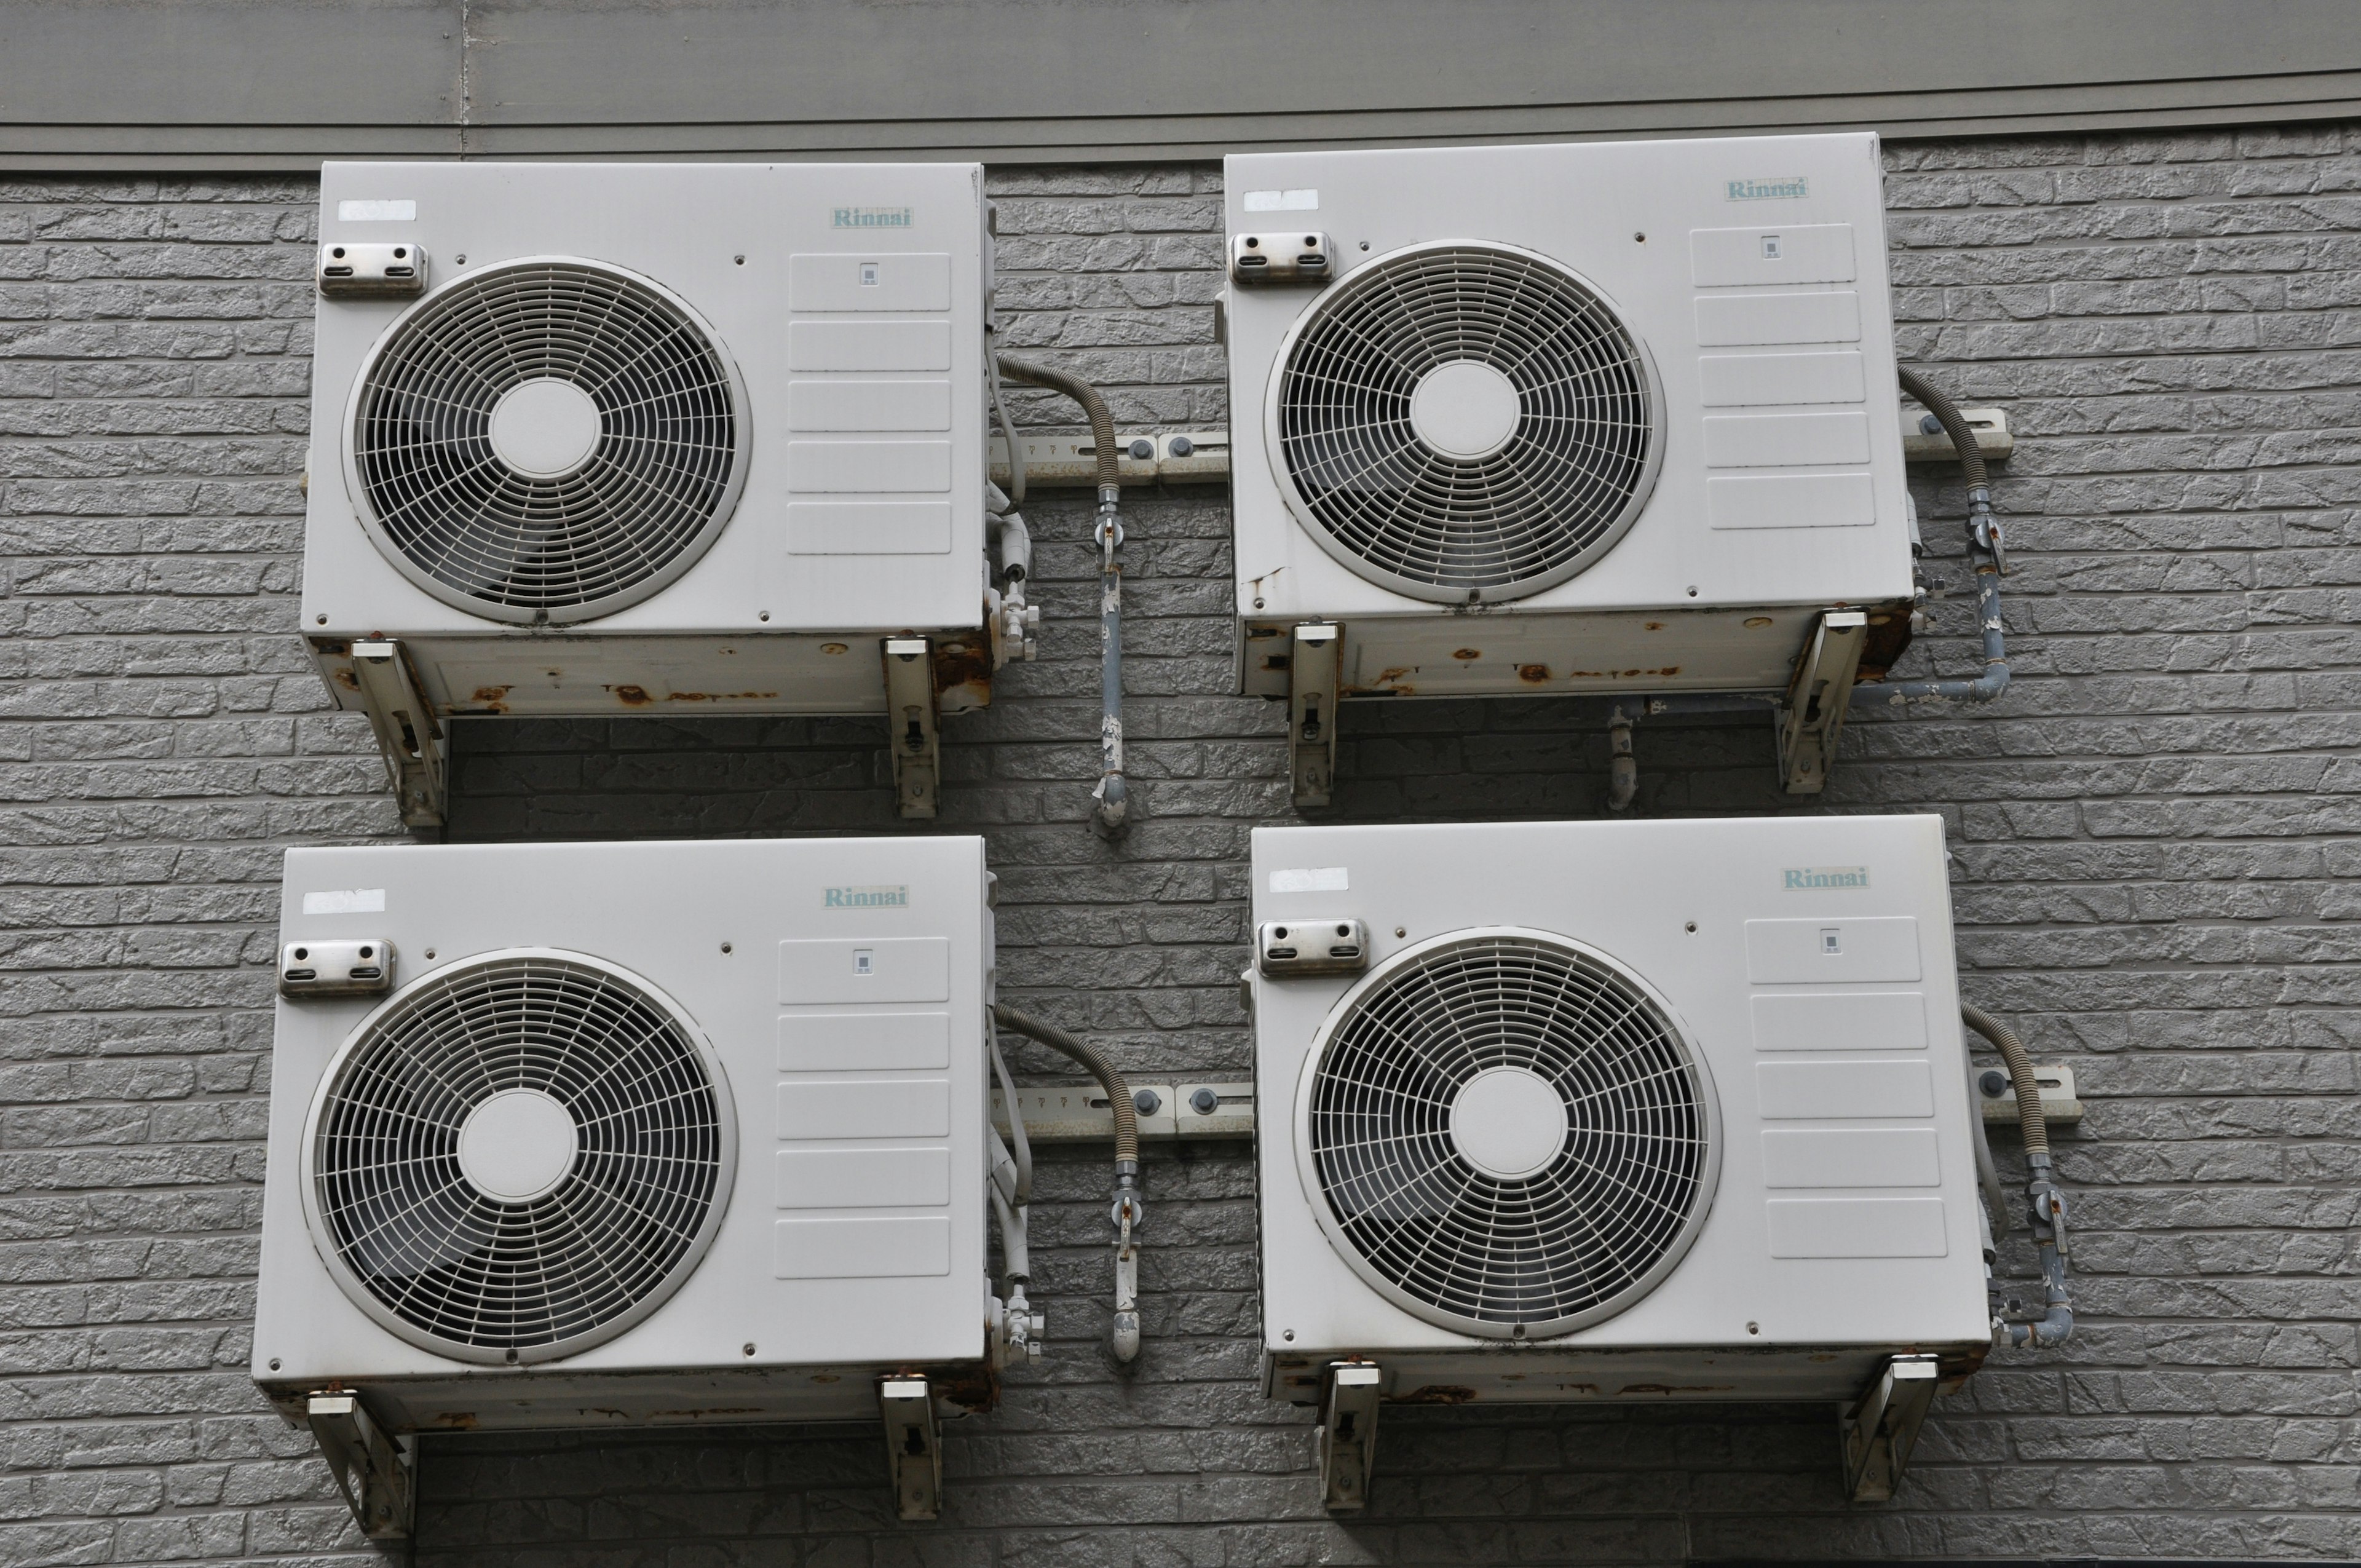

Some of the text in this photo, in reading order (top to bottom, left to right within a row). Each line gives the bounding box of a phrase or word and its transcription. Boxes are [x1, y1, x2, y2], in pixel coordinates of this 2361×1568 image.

[1727, 178, 1807, 199] Rinnai
[834, 208, 911, 226] Rinnai
[1784, 867, 1869, 889] Rinnai
[825, 885, 908, 906] Rinnai
